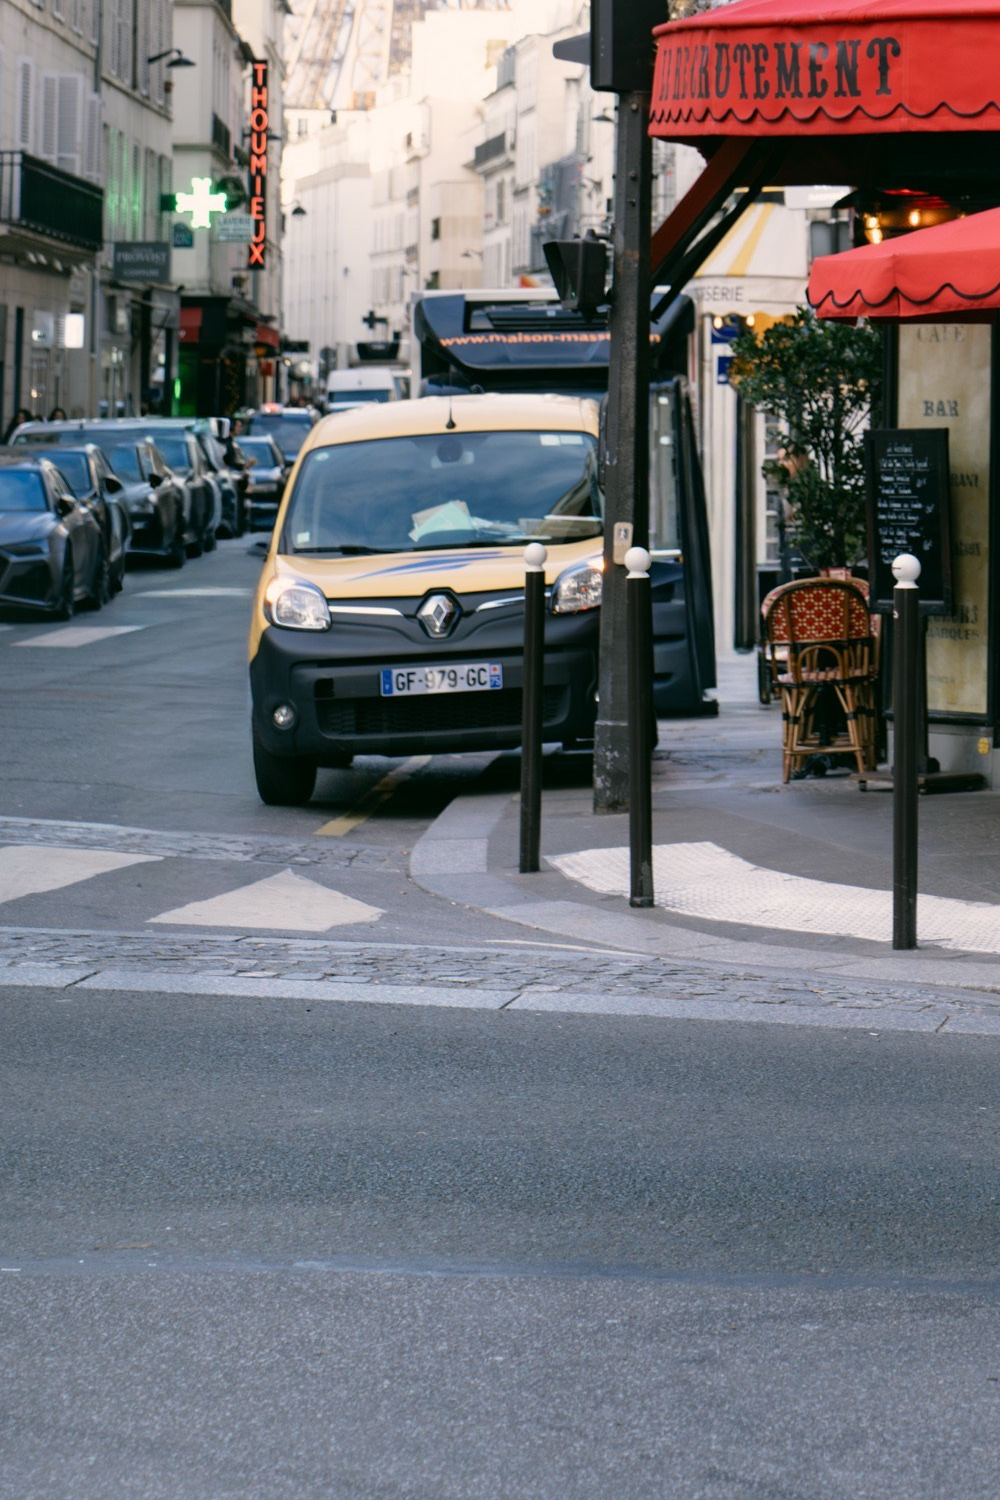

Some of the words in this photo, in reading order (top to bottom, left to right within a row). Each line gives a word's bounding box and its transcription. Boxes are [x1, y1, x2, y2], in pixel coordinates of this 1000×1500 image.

[250, 63, 269, 265] THOUMIEUX
[696, 286, 744, 302] SERIE
[923, 400, 960, 417] BAR
[395, 668, 488, 691] GF-979-GC
